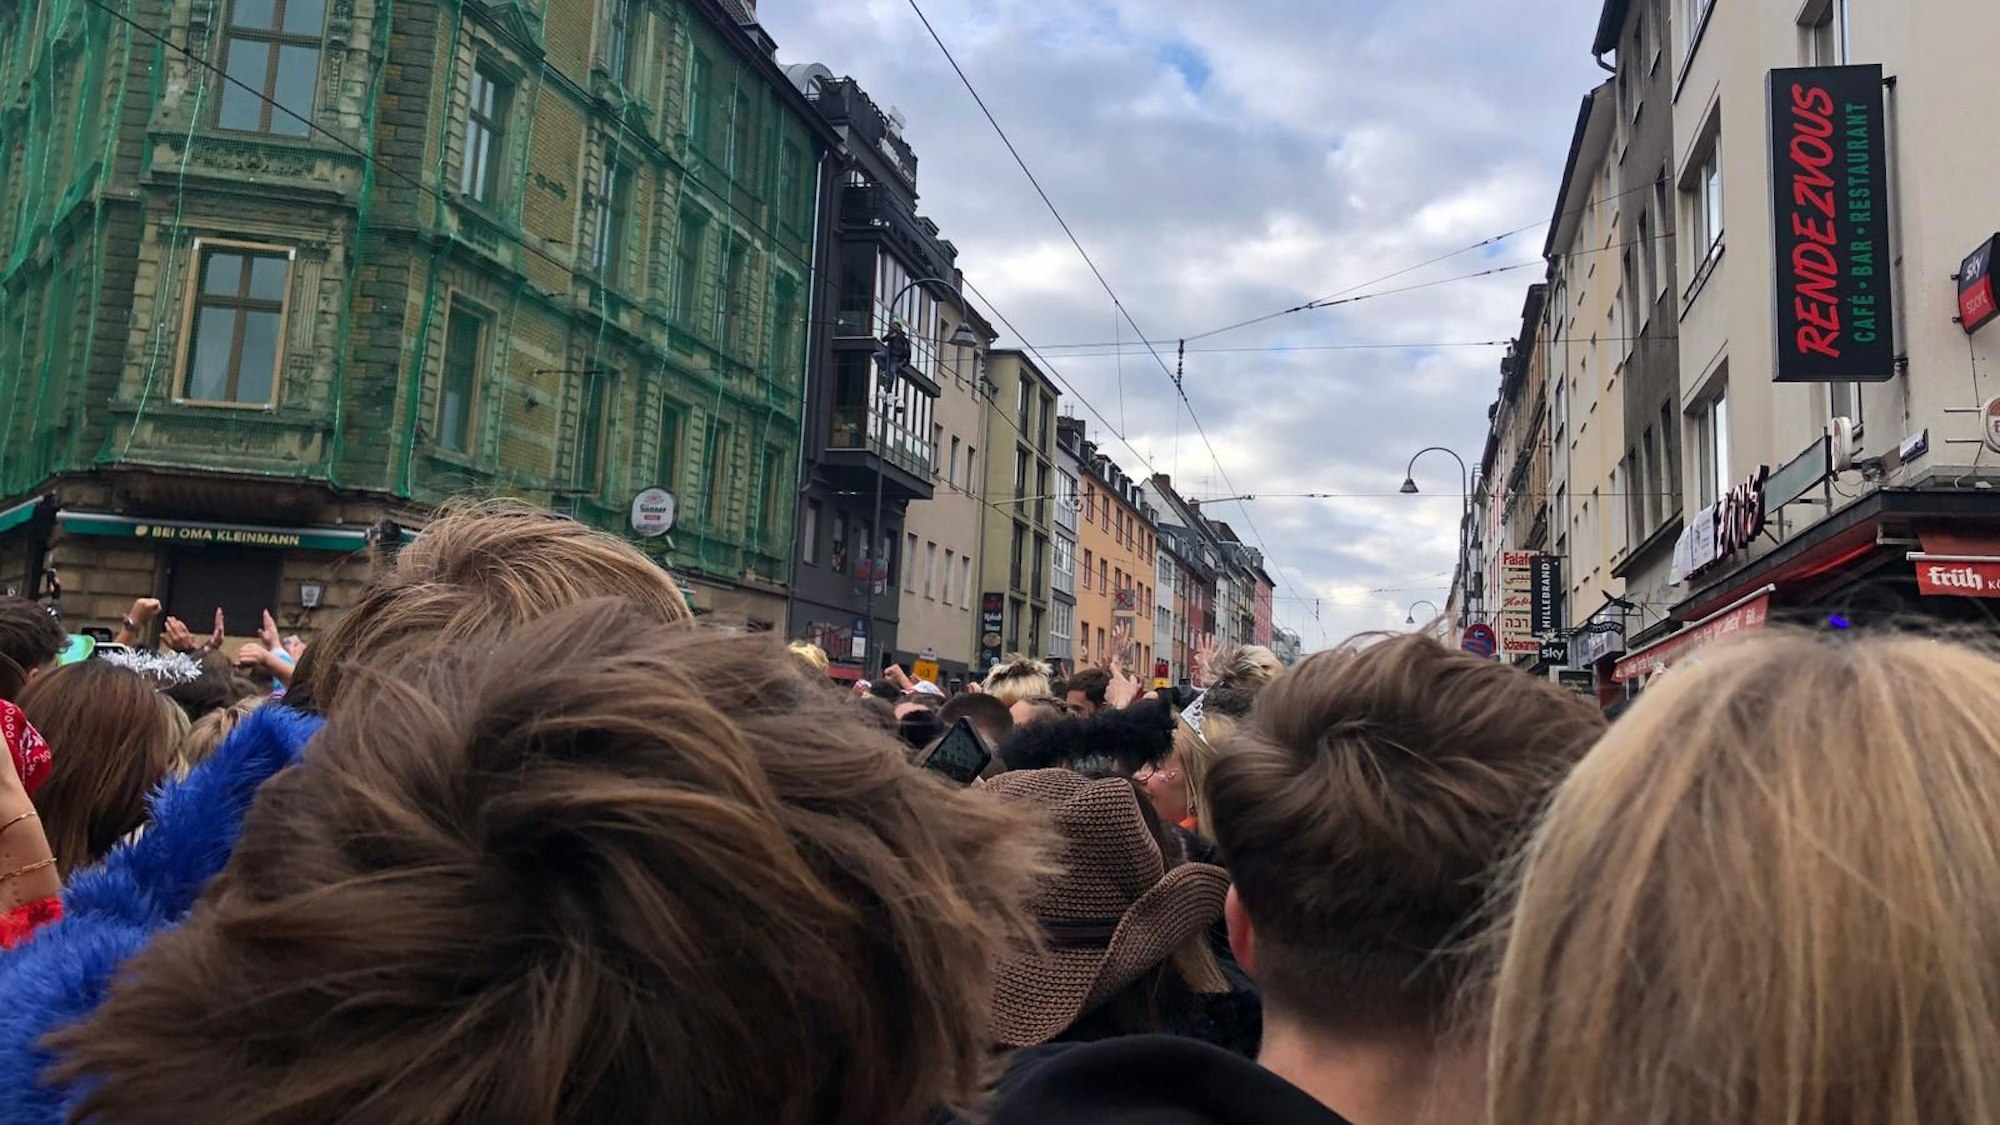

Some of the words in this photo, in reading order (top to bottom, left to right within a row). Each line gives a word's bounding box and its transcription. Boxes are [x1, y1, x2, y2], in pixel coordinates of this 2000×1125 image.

[1845, 103, 1871, 222] RESTAURANT
[1790, 84, 1840, 358] RENDEZVOUS
[1850, 239, 1873, 277] BAR
[1965, 253, 1984, 280] sky
[1966, 289, 1988, 315] sport
[1847, 295, 1876, 343] CAFÉ
[151, 526, 175, 538] BEI
[179, 527, 212, 540] OMA
[216, 530, 300, 546] KLEINMANN
[1503, 552, 1532, 565] Falaf
[1542, 647, 1565, 660] sky
